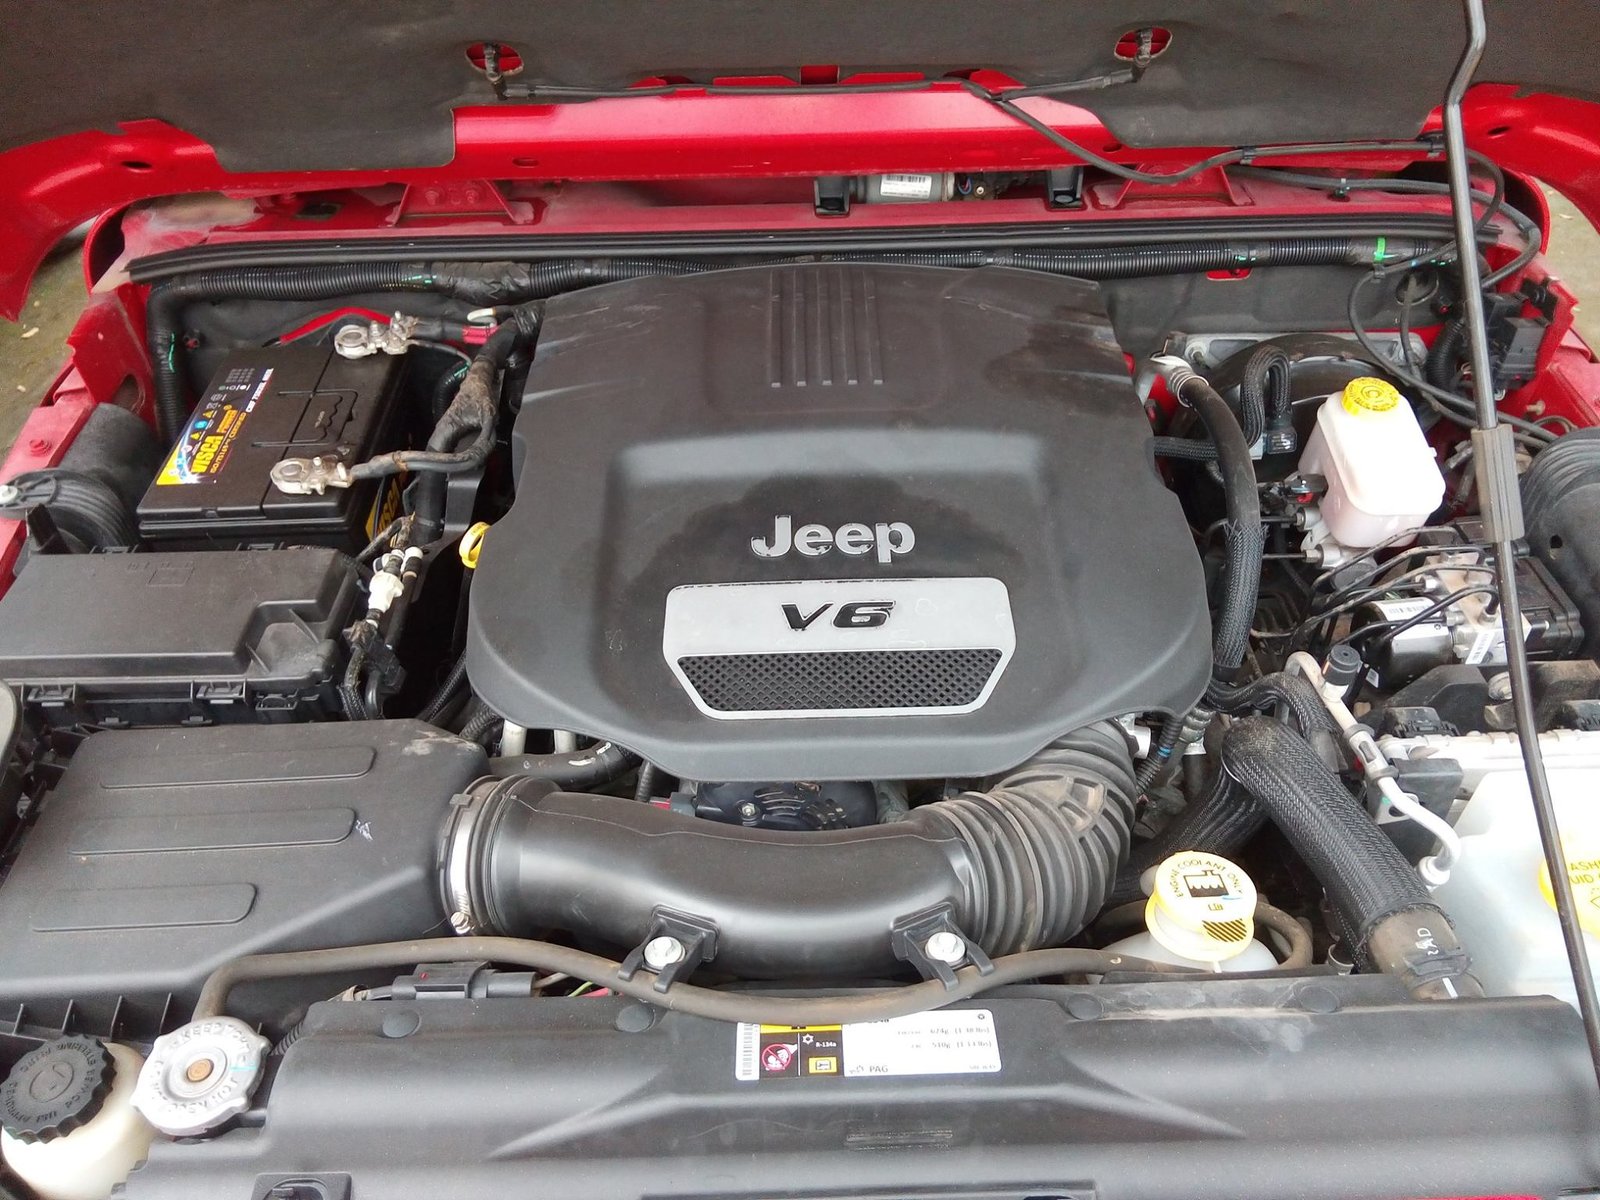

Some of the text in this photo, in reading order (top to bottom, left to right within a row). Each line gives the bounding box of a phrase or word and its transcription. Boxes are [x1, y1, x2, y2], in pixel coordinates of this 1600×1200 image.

[190, 435, 224, 473] VISCA
[750, 514, 915, 564] Jeep
[781, 600, 896, 631] V6
[1170, 858, 1243, 897] ENGINE COOLANT ONLY
[1569, 874, 1594, 884] UID
[1570, 860, 1600, 871] ASH
[56, 1042, 96, 1065] STEERING
[869, 1065, 889, 1073] PAG
